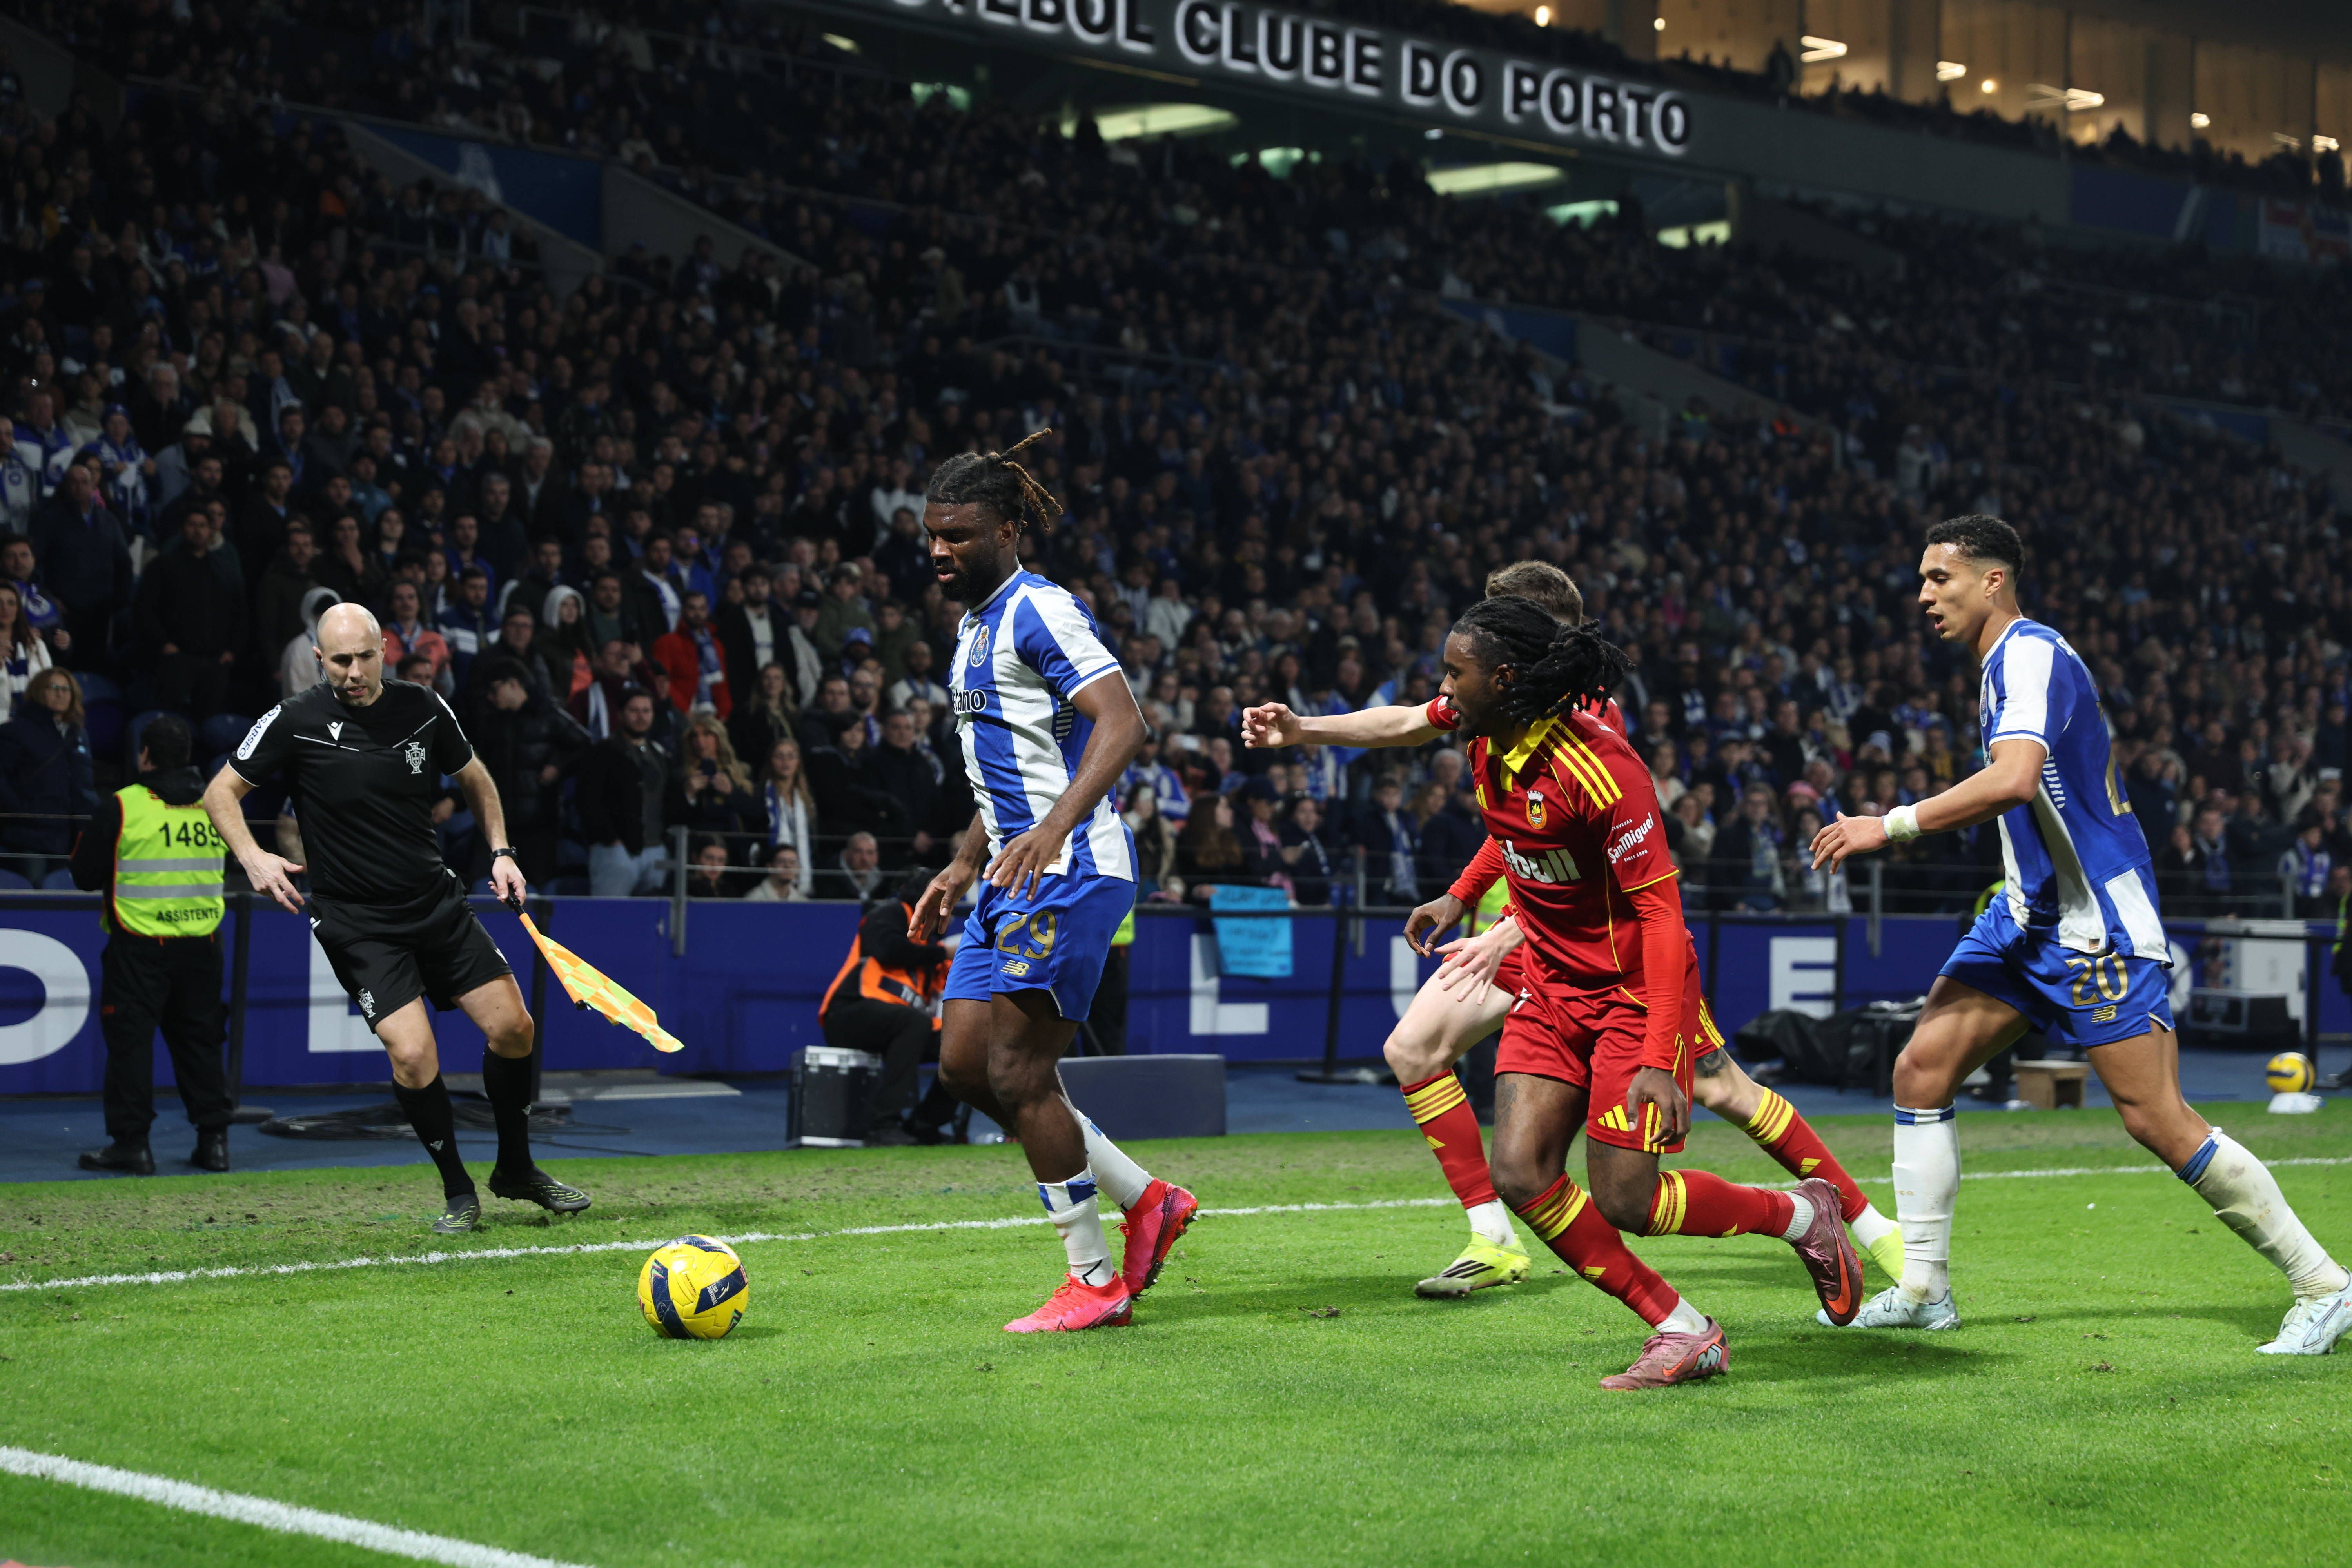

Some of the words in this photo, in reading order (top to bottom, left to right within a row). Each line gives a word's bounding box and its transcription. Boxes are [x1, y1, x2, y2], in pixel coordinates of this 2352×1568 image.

[1177, 1, 1383, 96] CLUBE
[1401, 38, 1484, 116] DO
[1503, 59, 1692, 155] PORTO
[239, 717, 267, 757] SABSEG
[159, 821, 220, 847] 1489
[1611, 818, 1633, 831] CERVEZAS
[156, 907, 220, 922] ASSISTENTE
[997, 910, 1056, 960] 29
[2065, 951, 2129, 1007] 20
[689, 1281, 698, 1296] FOOTBALL
[706, 1285, 718, 1306] PORTUGAL
